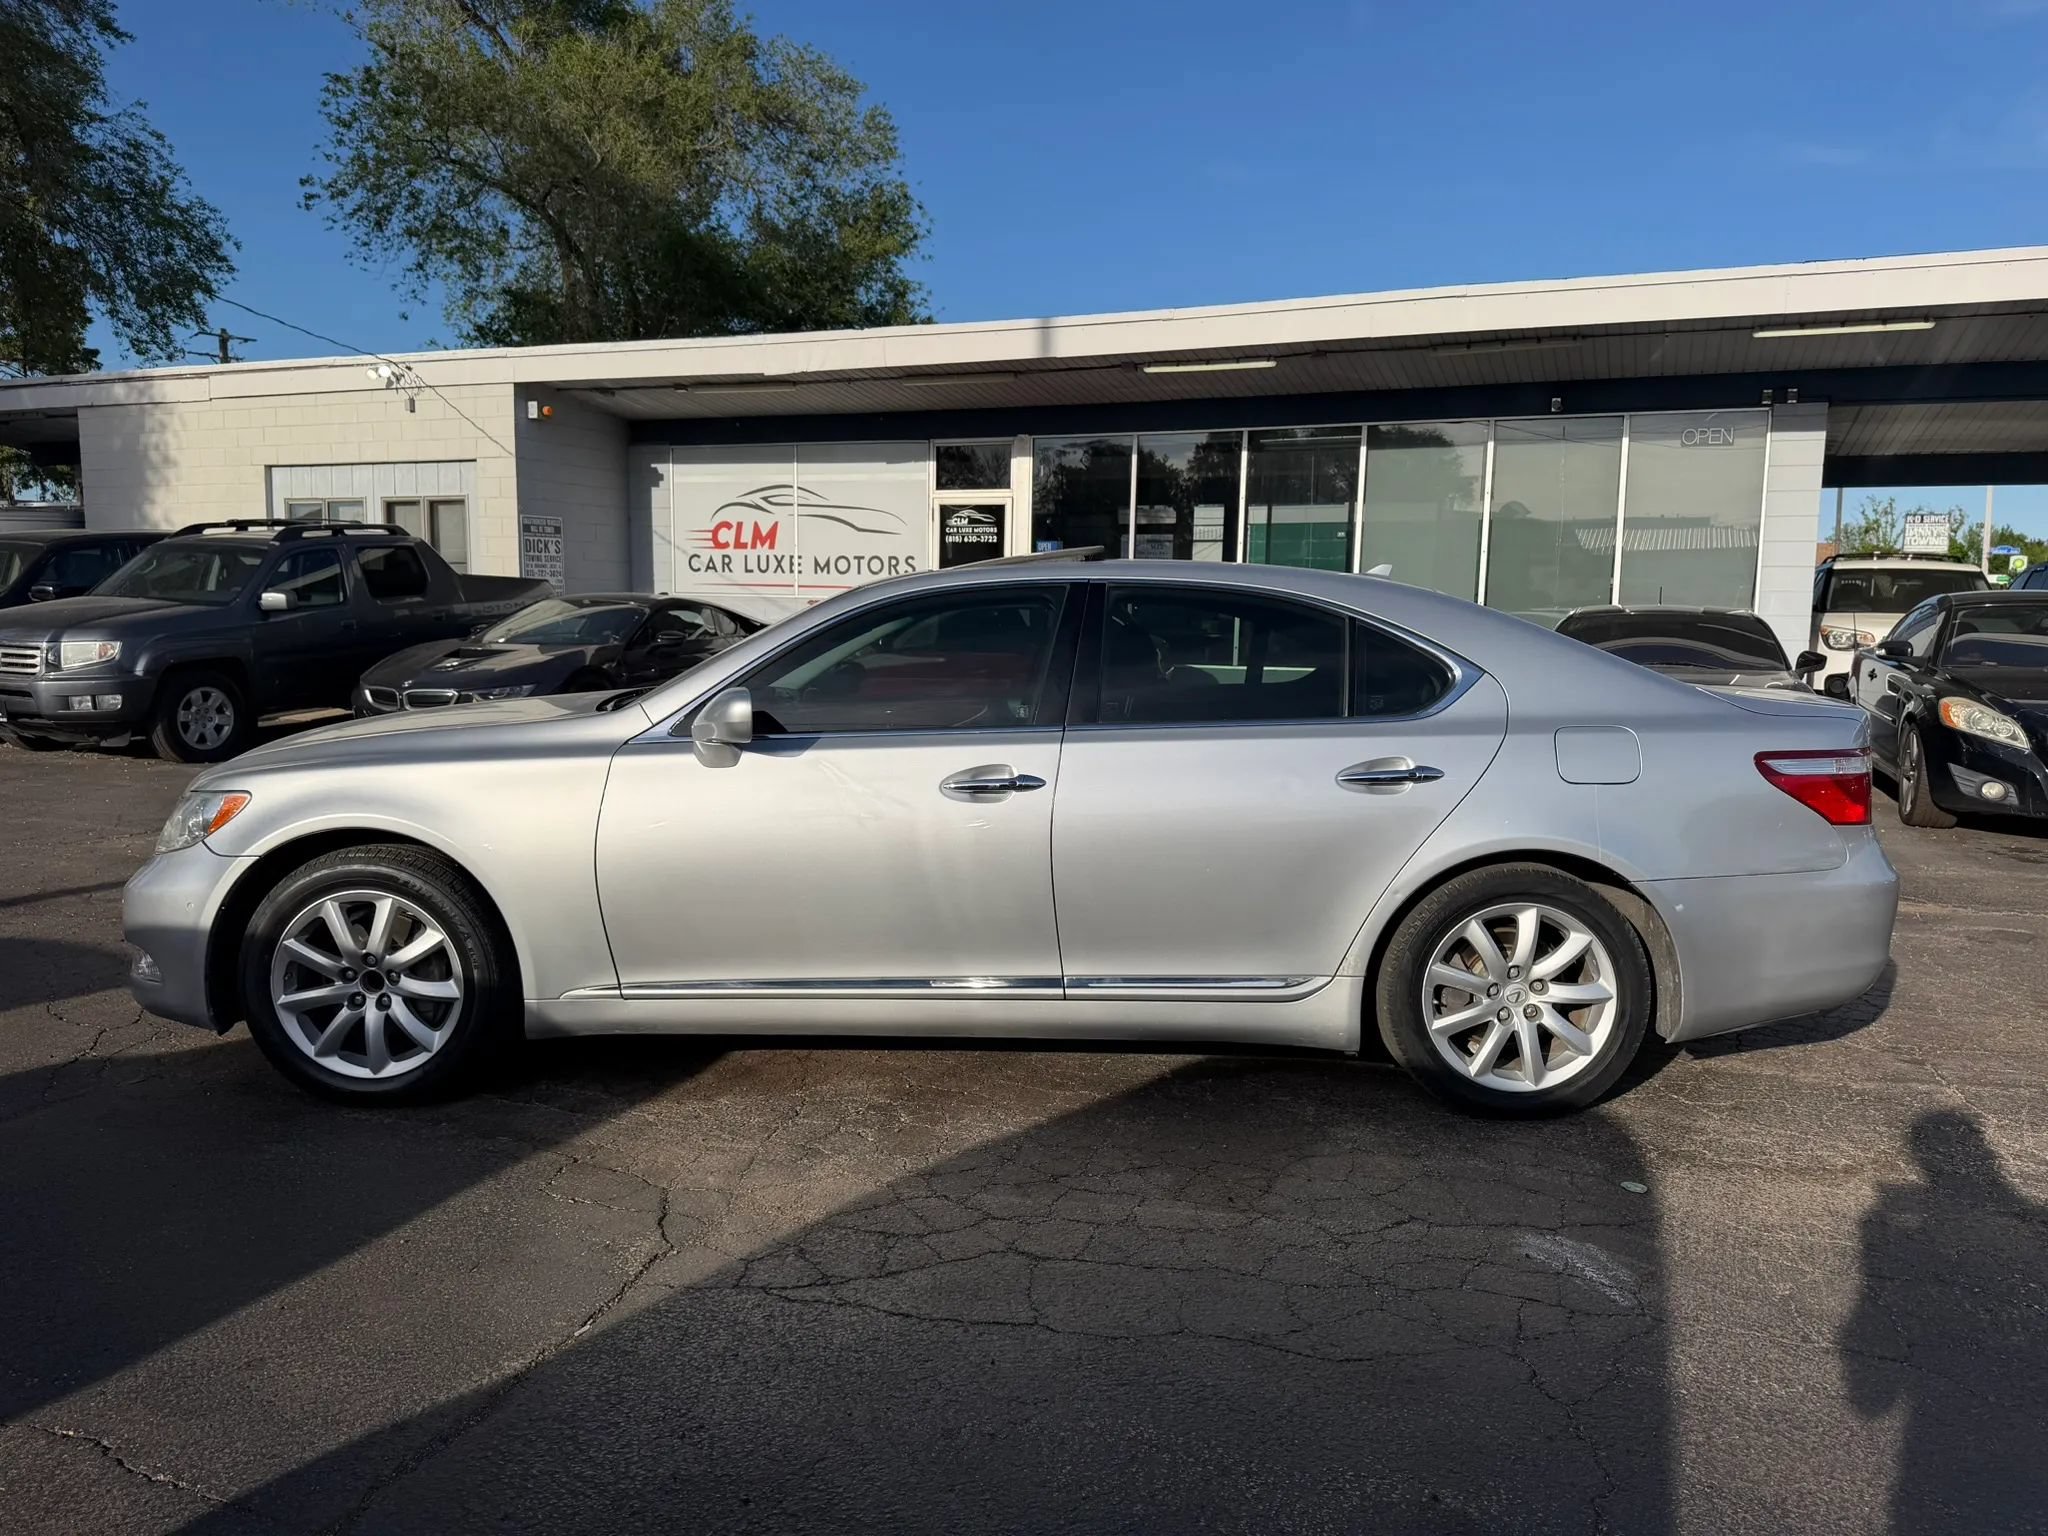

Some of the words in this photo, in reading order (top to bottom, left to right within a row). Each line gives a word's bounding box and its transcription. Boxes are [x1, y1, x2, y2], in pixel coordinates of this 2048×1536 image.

[1681, 427, 1734, 445] OPEN
[952, 517, 969, 525] CLM
[711, 521, 779, 550] CLM
[945, 535, 962, 544] (815)
[1904, 537, 1947, 545] TOWING
[525, 538, 561, 555] DICK'S
[544, 555, 562, 563] SERVICE
[688, 554, 733, 573] CAR
[744, 555, 803, 574] LUXE
[814, 555, 916, 576] MOTORS
